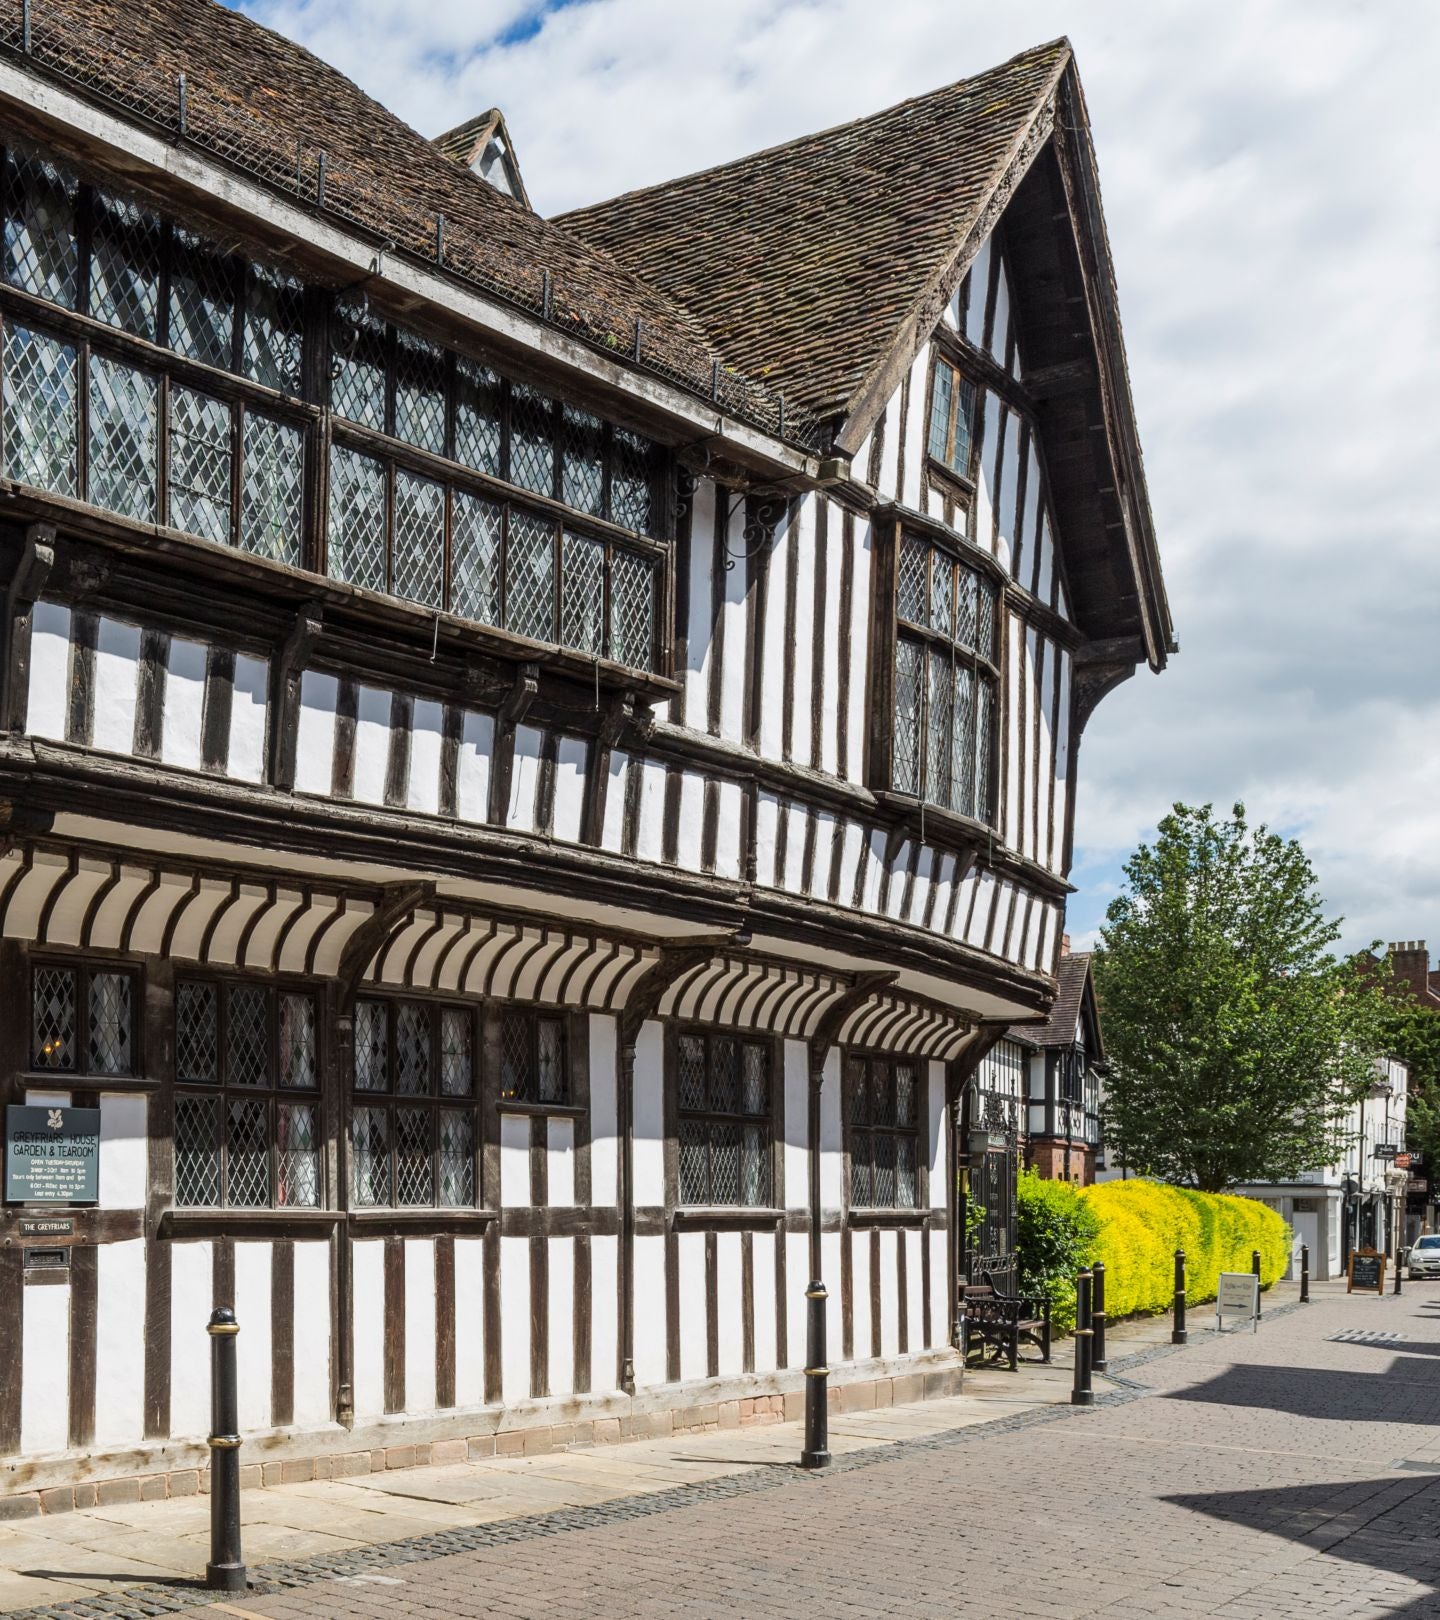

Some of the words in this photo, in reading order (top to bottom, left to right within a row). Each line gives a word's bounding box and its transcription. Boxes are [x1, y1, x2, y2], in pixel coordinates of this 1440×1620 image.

[13, 1131, 64, 1144] GREYFRIARS
[13, 1144, 47, 1157] GARDEN
[49, 1146, 55, 1157] &
[57, 1146, 94, 1158] TEAROOM
[24, 1223, 35, 1231] THE
[37, 1223, 70, 1231] GREYFRIARS
